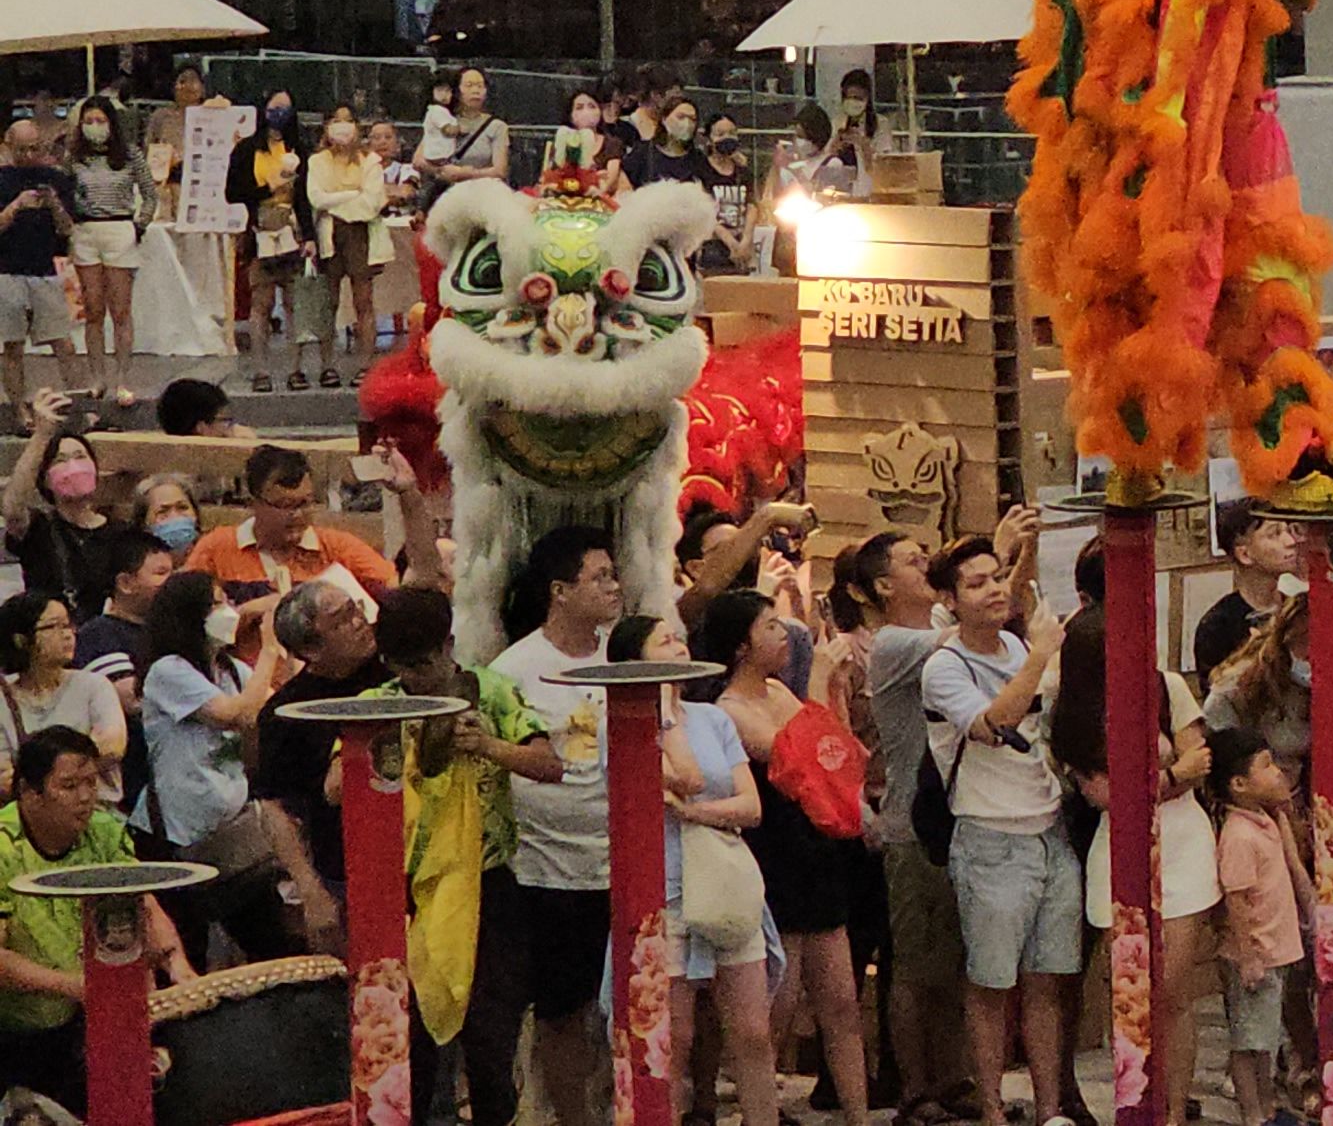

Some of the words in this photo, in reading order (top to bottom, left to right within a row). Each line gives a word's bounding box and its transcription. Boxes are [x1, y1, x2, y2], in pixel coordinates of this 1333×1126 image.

[859, 281, 923, 308] BARU
[819, 311, 877, 339] SERI
[885, 313, 963, 344] SETIA
